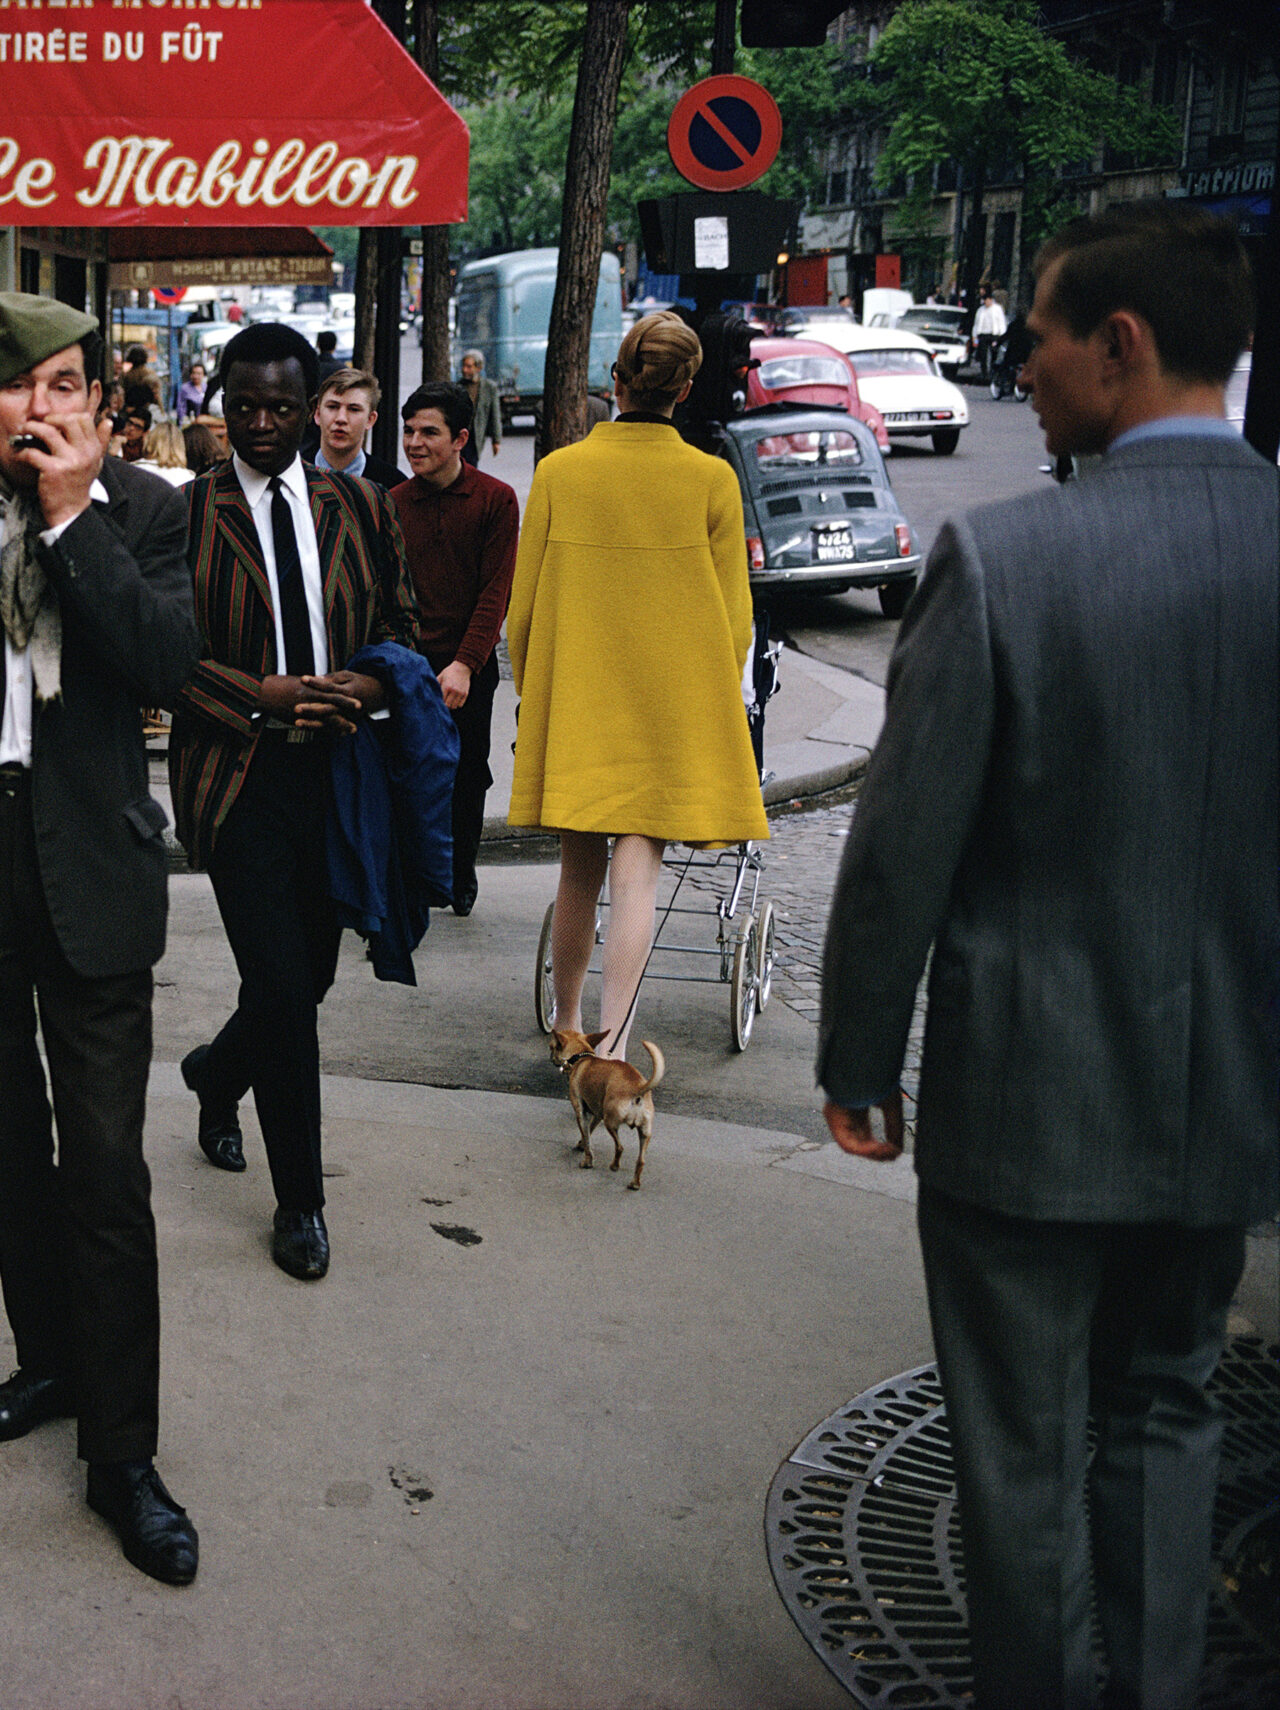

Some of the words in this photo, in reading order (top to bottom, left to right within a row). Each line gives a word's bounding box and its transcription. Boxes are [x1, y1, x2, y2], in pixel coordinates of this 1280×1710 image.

[102, 31, 145, 62] DU
[161, 22, 223, 62] FÛT
[75, 135, 420, 209] Mabillon
